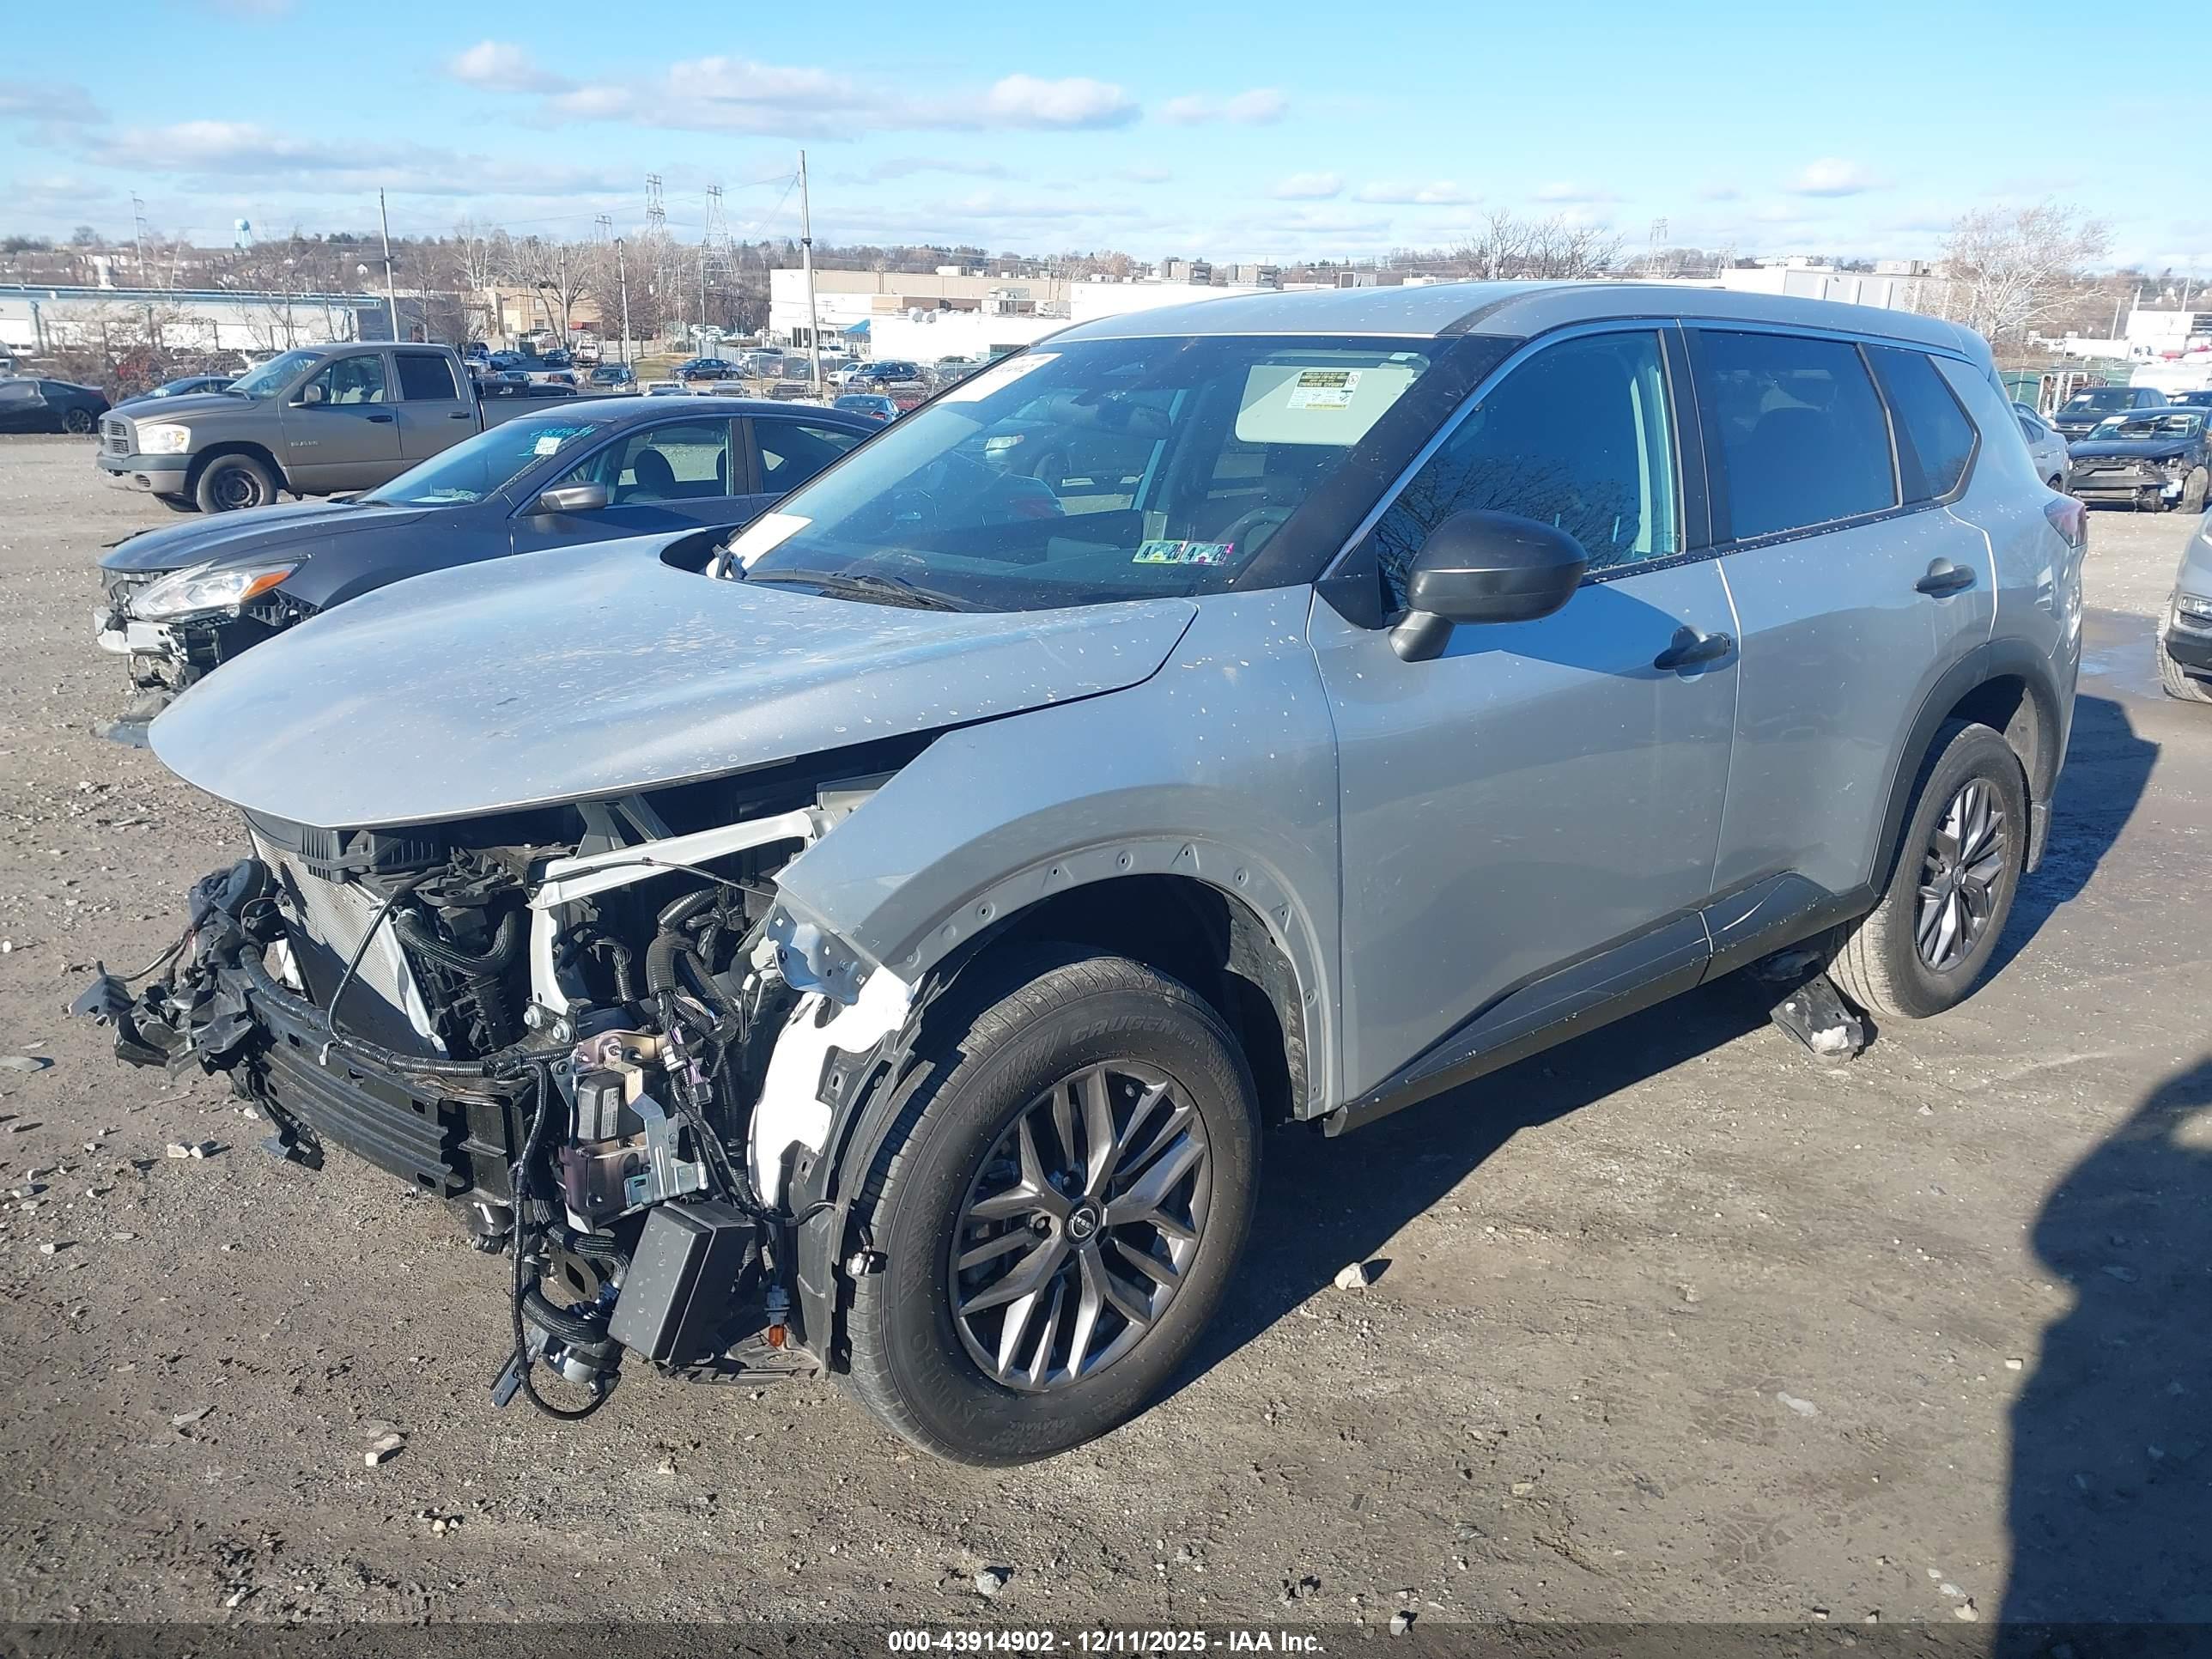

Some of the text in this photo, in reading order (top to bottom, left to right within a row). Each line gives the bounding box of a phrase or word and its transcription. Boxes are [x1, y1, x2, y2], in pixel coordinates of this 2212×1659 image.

[1140, 544, 1152, 559] 4
[1185, 546, 1198, 562] 4
[1071, 1212, 1096, 1233] NISSAN
